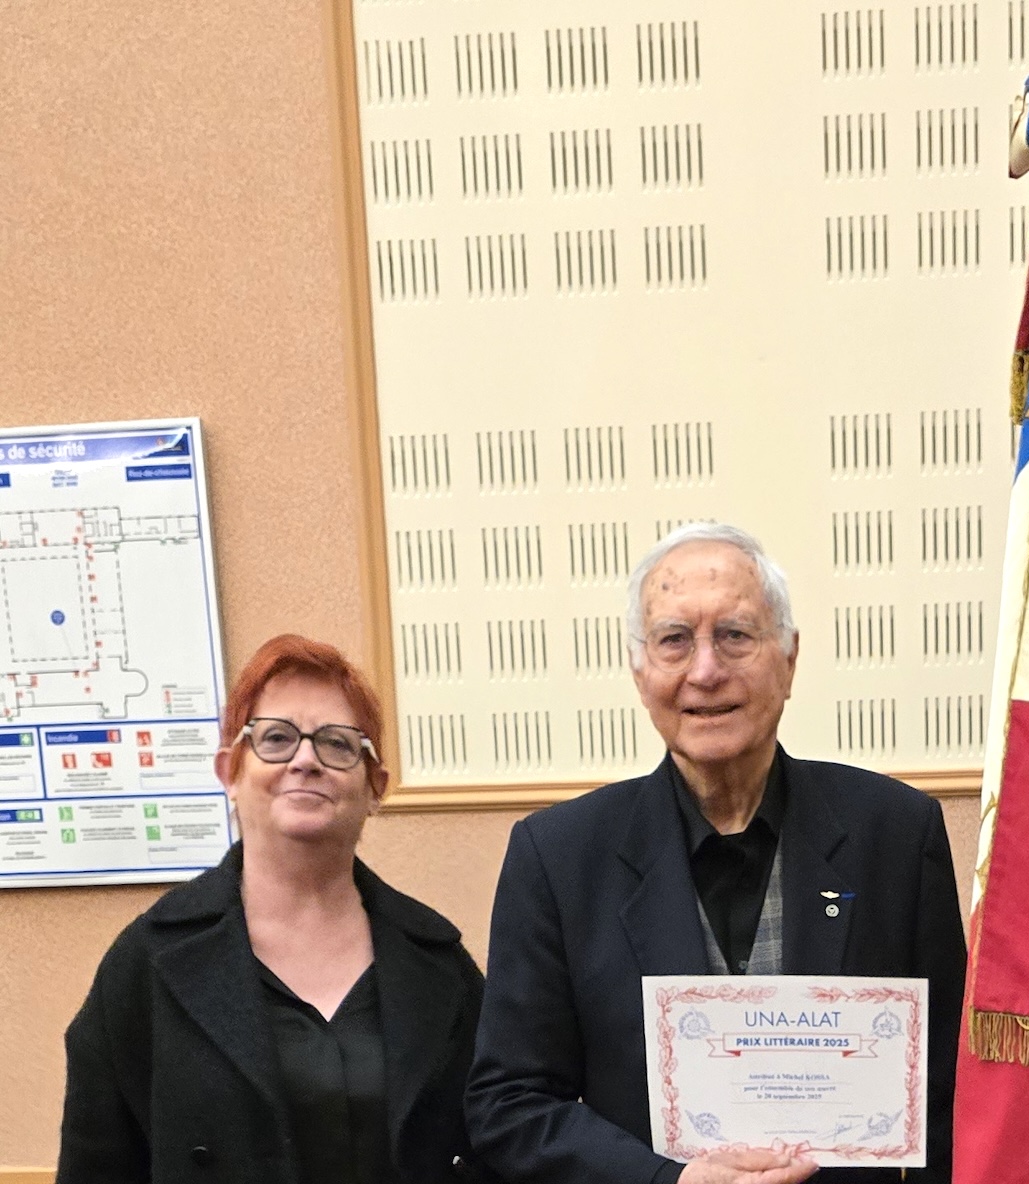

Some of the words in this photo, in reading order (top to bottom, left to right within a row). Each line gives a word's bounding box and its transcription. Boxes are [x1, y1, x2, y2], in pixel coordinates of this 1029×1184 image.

[8, 444, 26, 460] de
[28, 440, 86, 459] sécurité
[744, 1011, 842, 1028] UNA-ALAT
[736, 1037, 761, 1047] PRIX
[764, 1036, 820, 1047] LITTÉRAIRE
[823, 1038, 850, 1047] 2025
